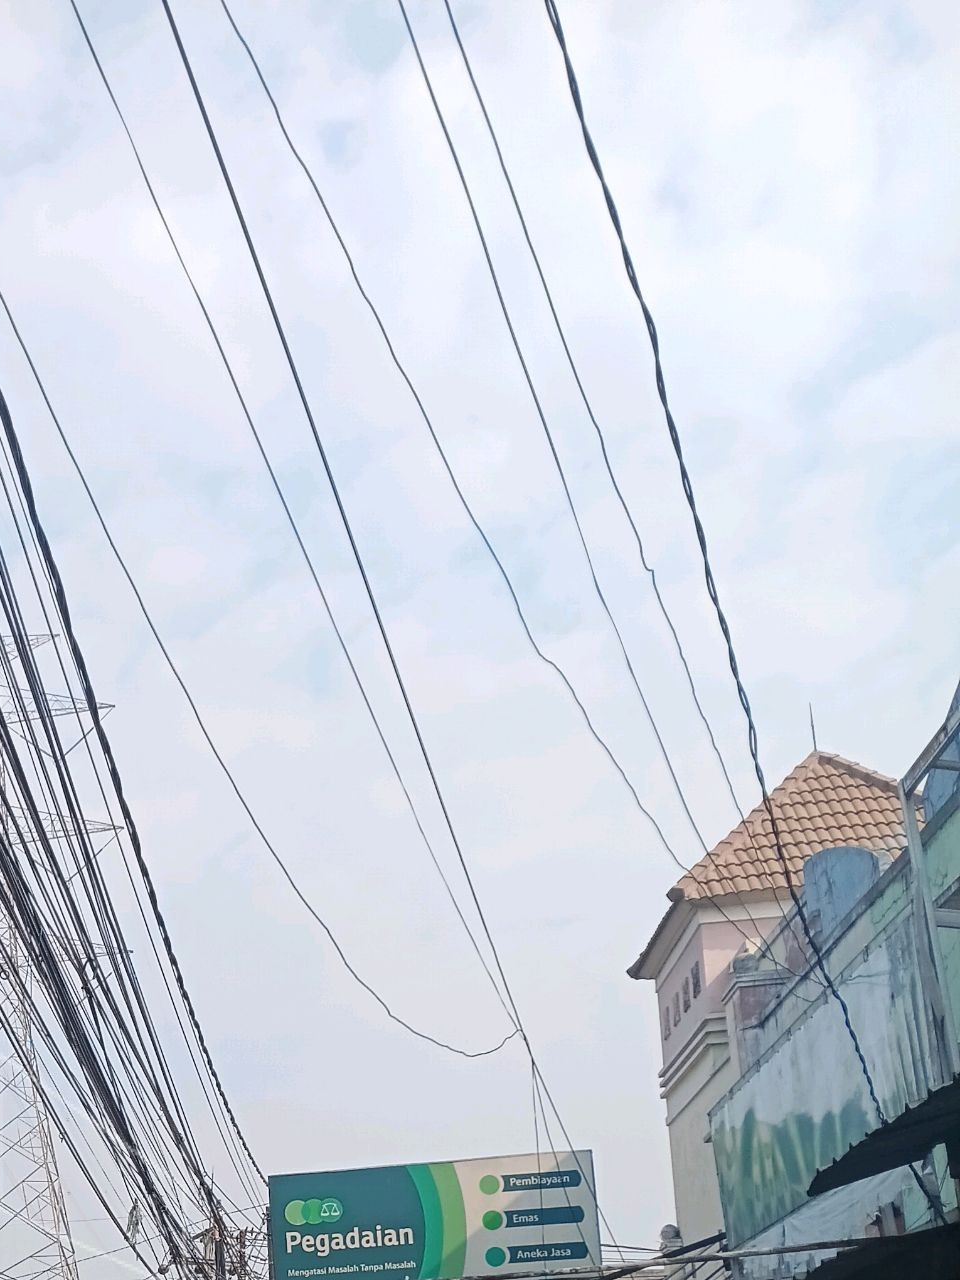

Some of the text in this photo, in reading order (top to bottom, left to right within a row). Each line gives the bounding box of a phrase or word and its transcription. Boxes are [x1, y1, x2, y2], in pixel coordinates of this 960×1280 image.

[509, 1175, 570, 1186] Pembiayaan
[512, 1214, 540, 1223] Emas
[285, 1224, 414, 1257] Pegadaian
[516, 1247, 572, 1259] Aneka Jasa
[287, 1260, 417, 1278] Mengatasi Masalah Tanpa Masalah
